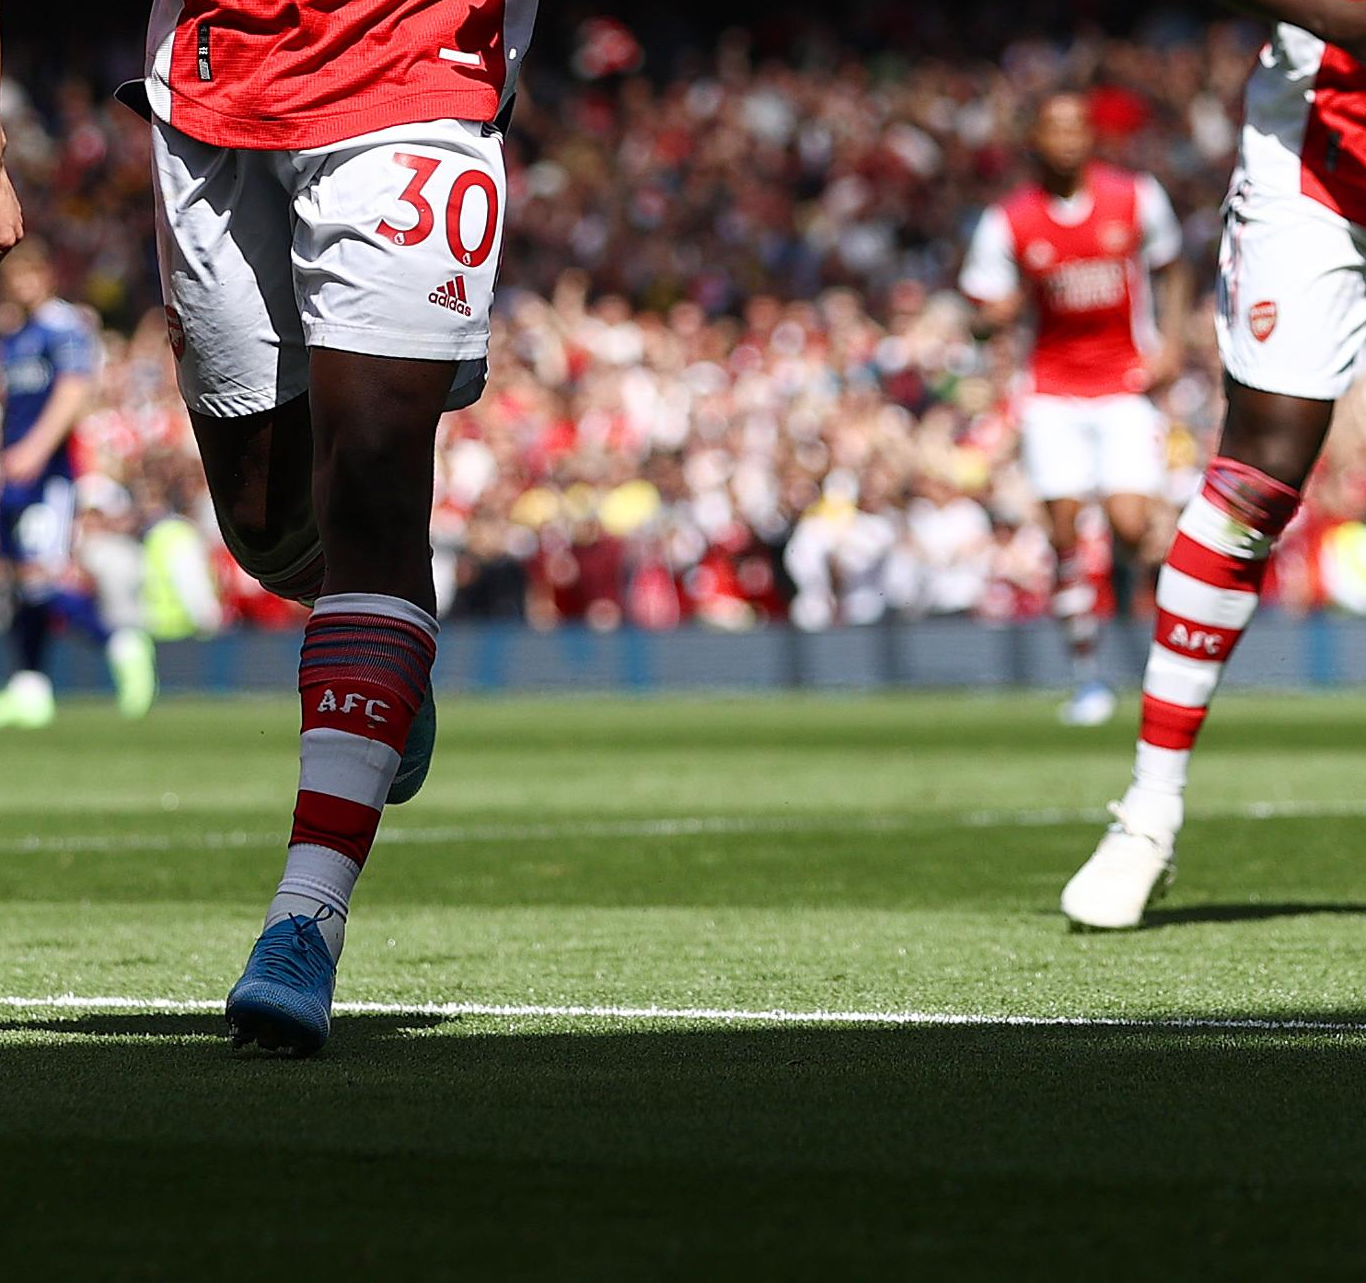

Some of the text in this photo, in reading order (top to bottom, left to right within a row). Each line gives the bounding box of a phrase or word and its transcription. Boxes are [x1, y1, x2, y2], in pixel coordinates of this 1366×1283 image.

[375, 151, 499, 268] 30
[428, 289, 472, 317] adidas
[1168, 623, 1223, 655] AFC
[317, 688, 392, 723] AFC
